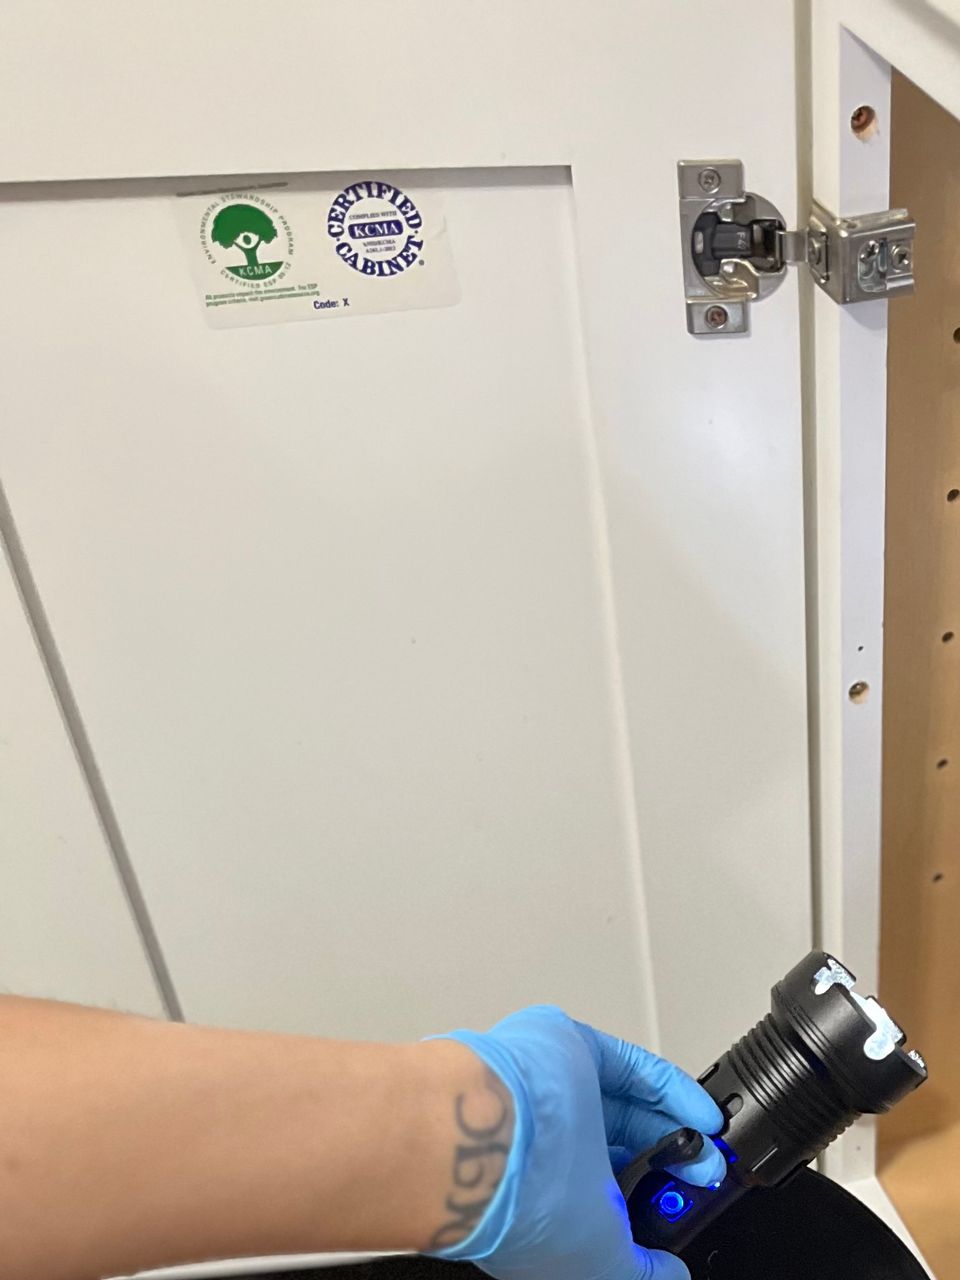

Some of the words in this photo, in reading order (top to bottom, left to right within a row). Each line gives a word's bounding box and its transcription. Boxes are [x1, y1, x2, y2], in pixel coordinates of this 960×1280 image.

[327, 181, 423, 239] CERTIFIED
[354, 222, 399, 239] KCMA
[335, 234, 425, 278] CABINET
[239, 263, 274, 278] KCMA
[313, 300, 340, 311] Code:
[342, 297, 350, 308] X
